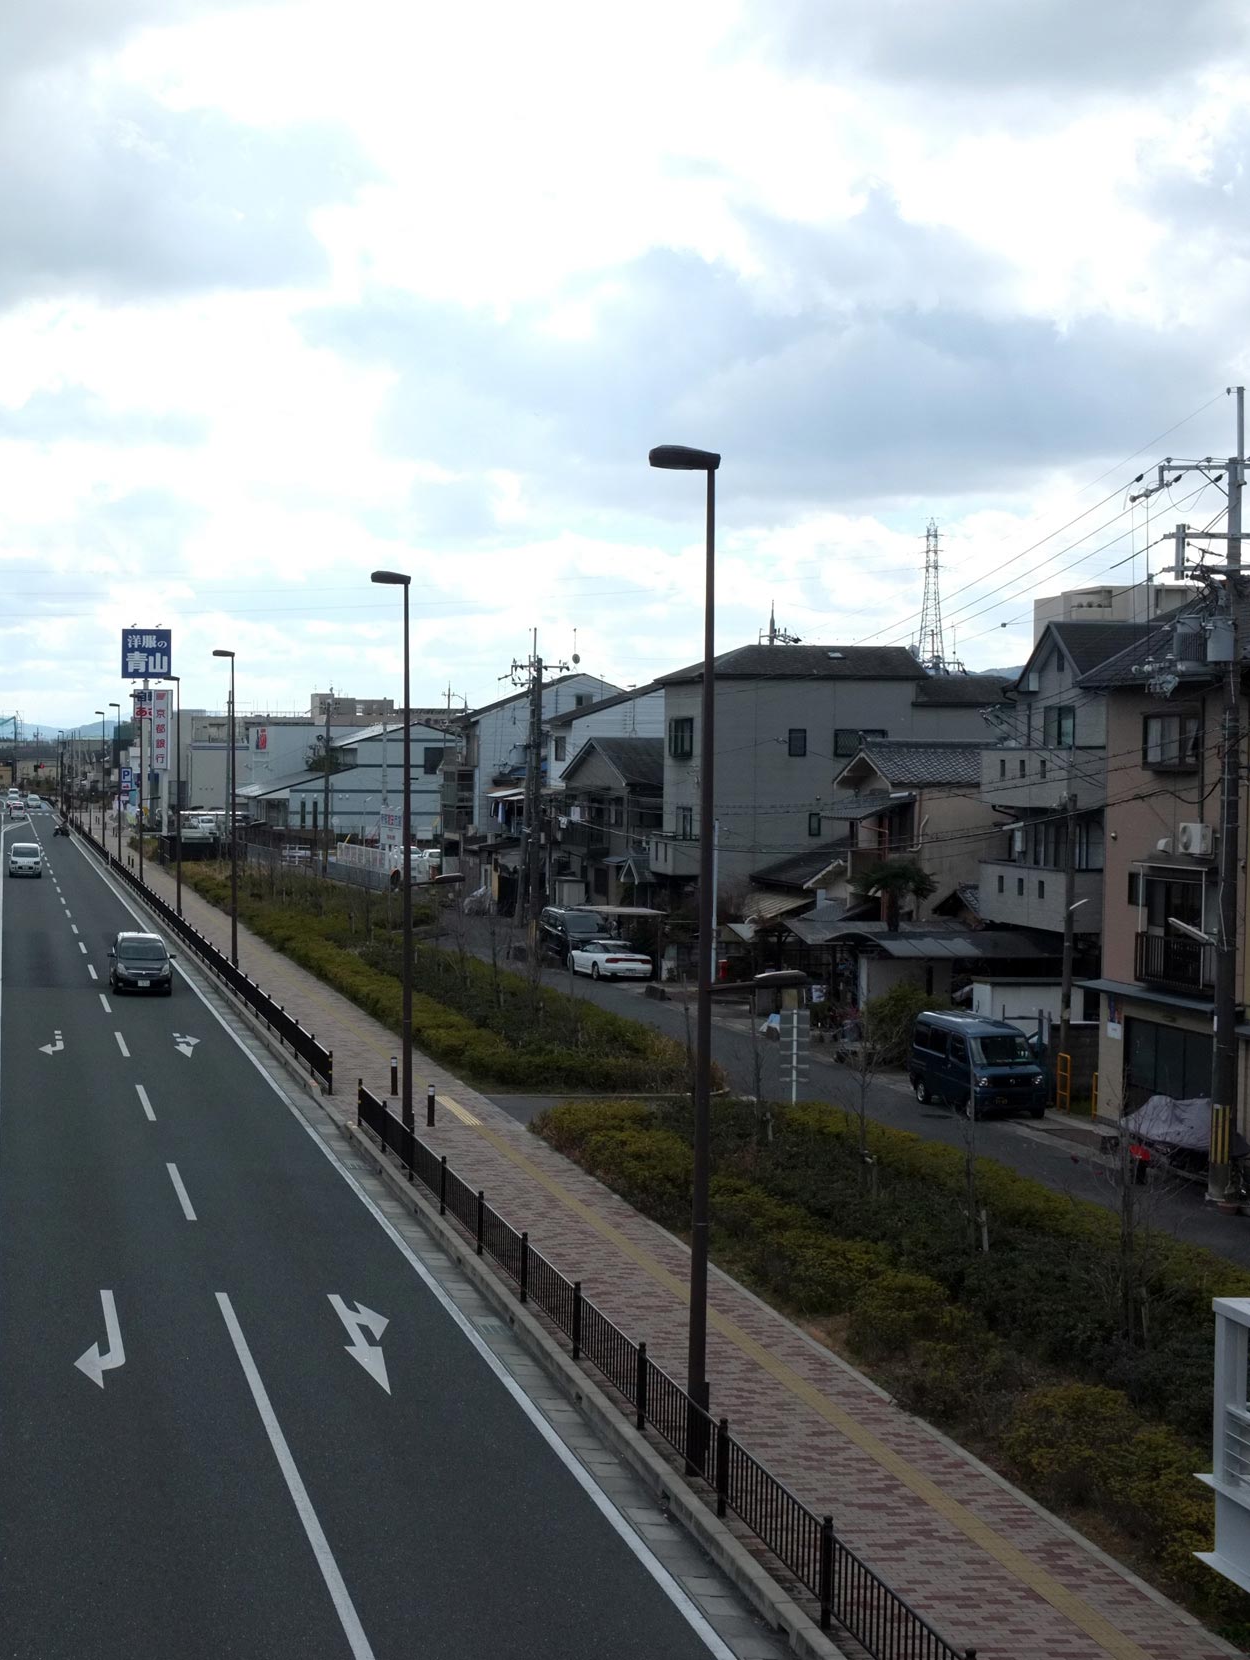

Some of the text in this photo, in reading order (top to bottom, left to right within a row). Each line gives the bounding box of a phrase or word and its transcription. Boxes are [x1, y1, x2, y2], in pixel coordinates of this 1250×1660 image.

[127, 635, 168, 649] 洋服の
[126, 651, 168, 673] 青山
[155, 709, 166, 764] 京都銀行
